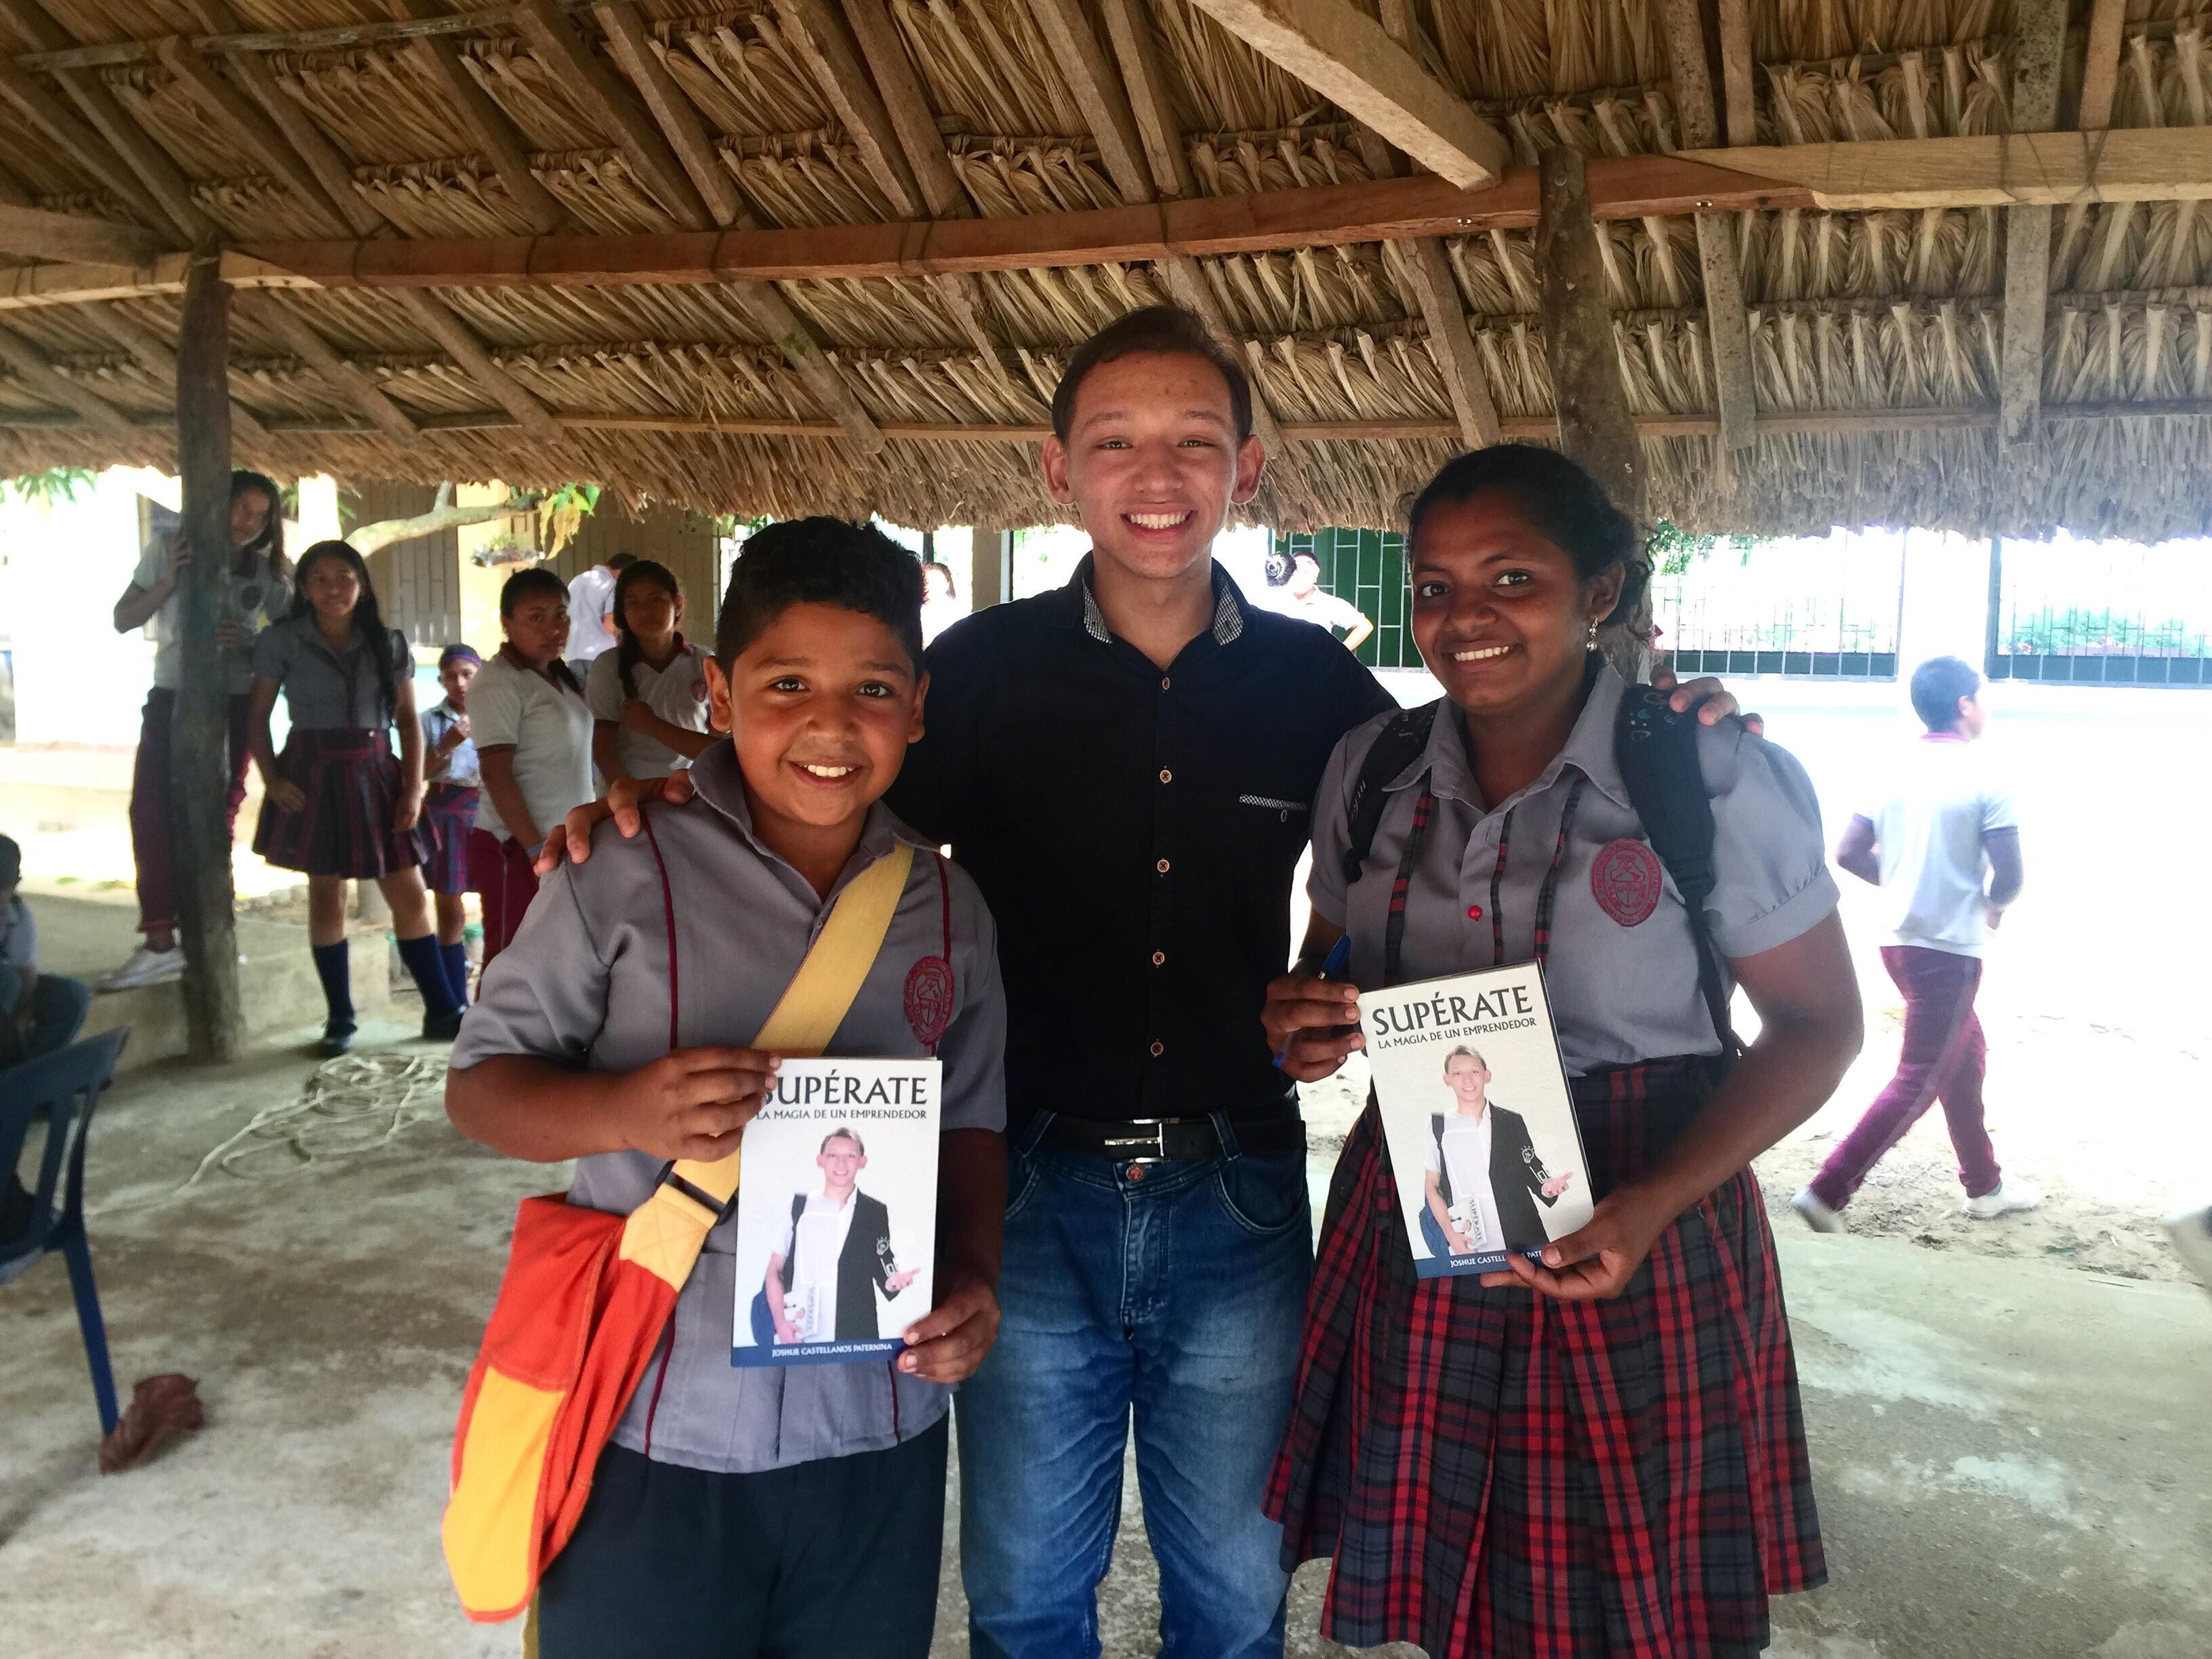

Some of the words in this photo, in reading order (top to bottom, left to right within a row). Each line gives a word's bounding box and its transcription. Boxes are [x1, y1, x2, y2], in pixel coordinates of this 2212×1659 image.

[1372, 985, 1533, 1036] SUPÉRATE
[1378, 1040, 1392, 1049] LA
[1393, 1034, 1427, 1046] MAGIA
[1429, 1031, 1442, 1041] DE
[1444, 1028, 1460, 1038] UN
[1463, 1017, 1537, 1036] EMPRENDEDOR
[756, 1110, 770, 1120] LA
[774, 1109, 811, 1119] MAGIA
[814, 1109, 827, 1118] DE
[830, 1109, 846, 1118] UN
[851, 1109, 927, 1119] EMPRENDEDOR
[1450, 1258, 1476, 1268] JOSHUE
[772, 1348, 800, 1357] JOSHUE
[801, 1345, 852, 1355] CASTELLANOS
[853, 1343, 893, 1352] PATERNINA
